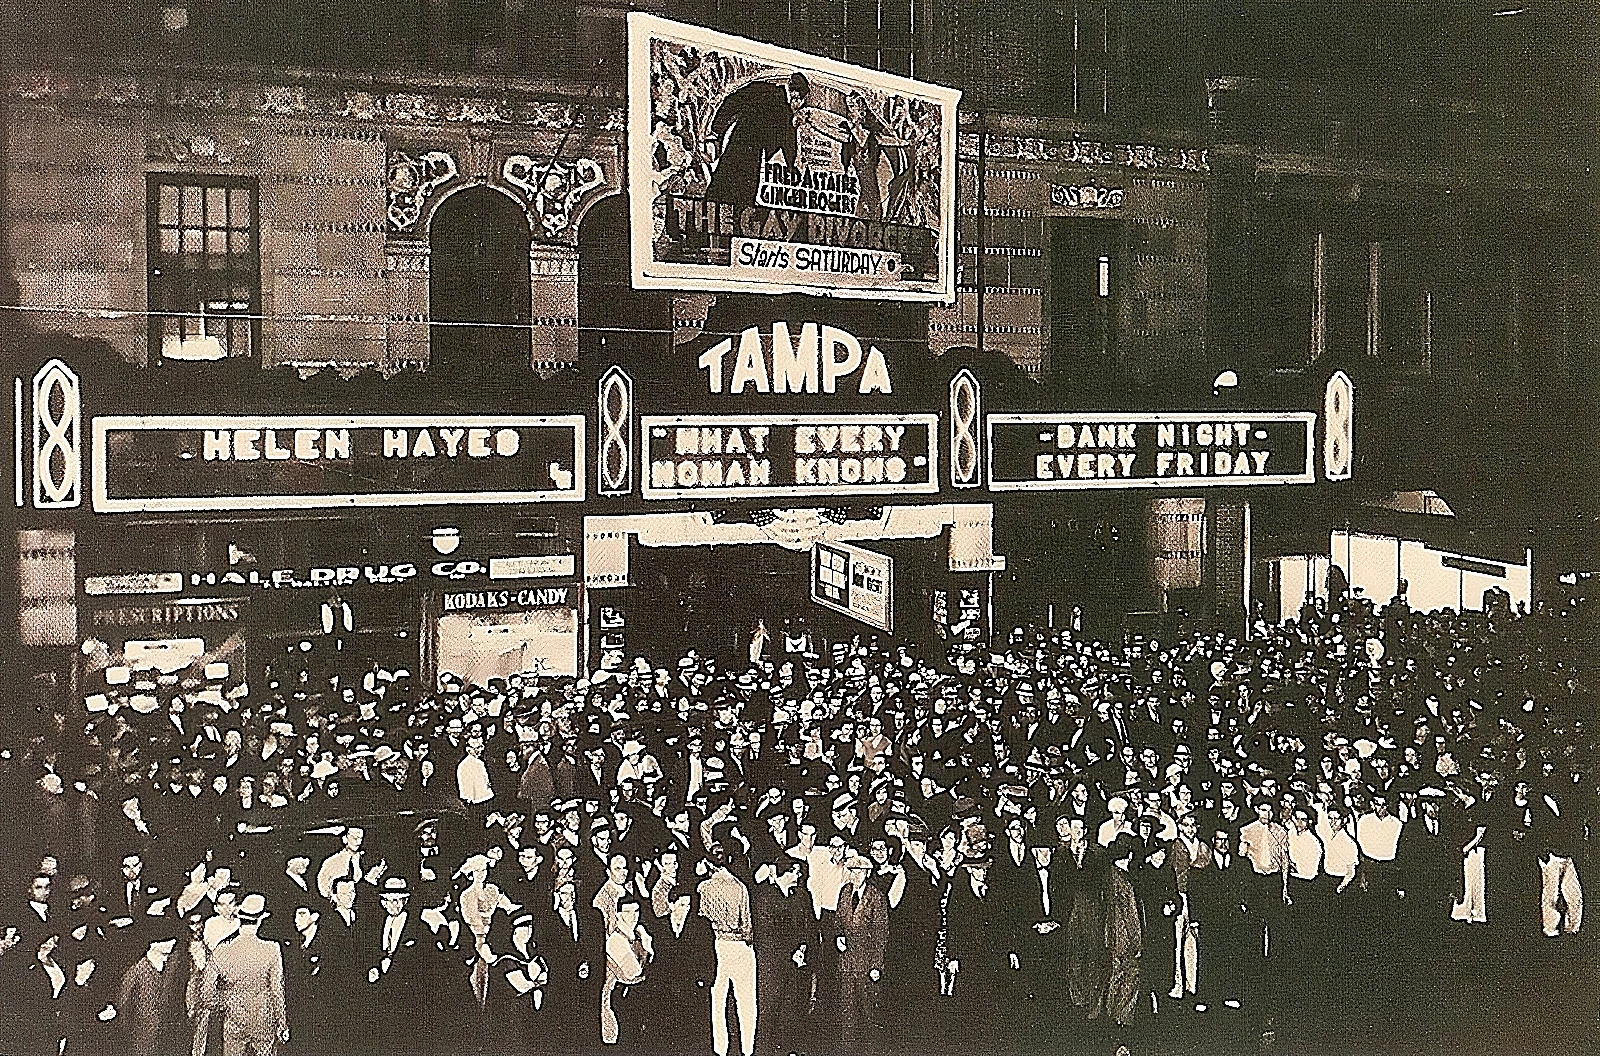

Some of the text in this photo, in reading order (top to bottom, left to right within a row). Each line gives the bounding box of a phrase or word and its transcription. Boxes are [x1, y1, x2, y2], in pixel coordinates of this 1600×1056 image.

[763, 162, 859, 194] FRED ASTAIRE
[760, 184, 807, 209] GINGER
[673, 197, 734, 236] THE
[740, 206, 803, 243] GAY
[738, 242, 883, 274] Starts SATURDAY
[699, 321, 893, 394] TAMPA
[202, 428, 351, 461] HELEN
[795, 425, 905, 454] EVERY
[1036, 450, 1270, 479] EVERY FRIDAY
[309, 563, 417, 582] DRUG
